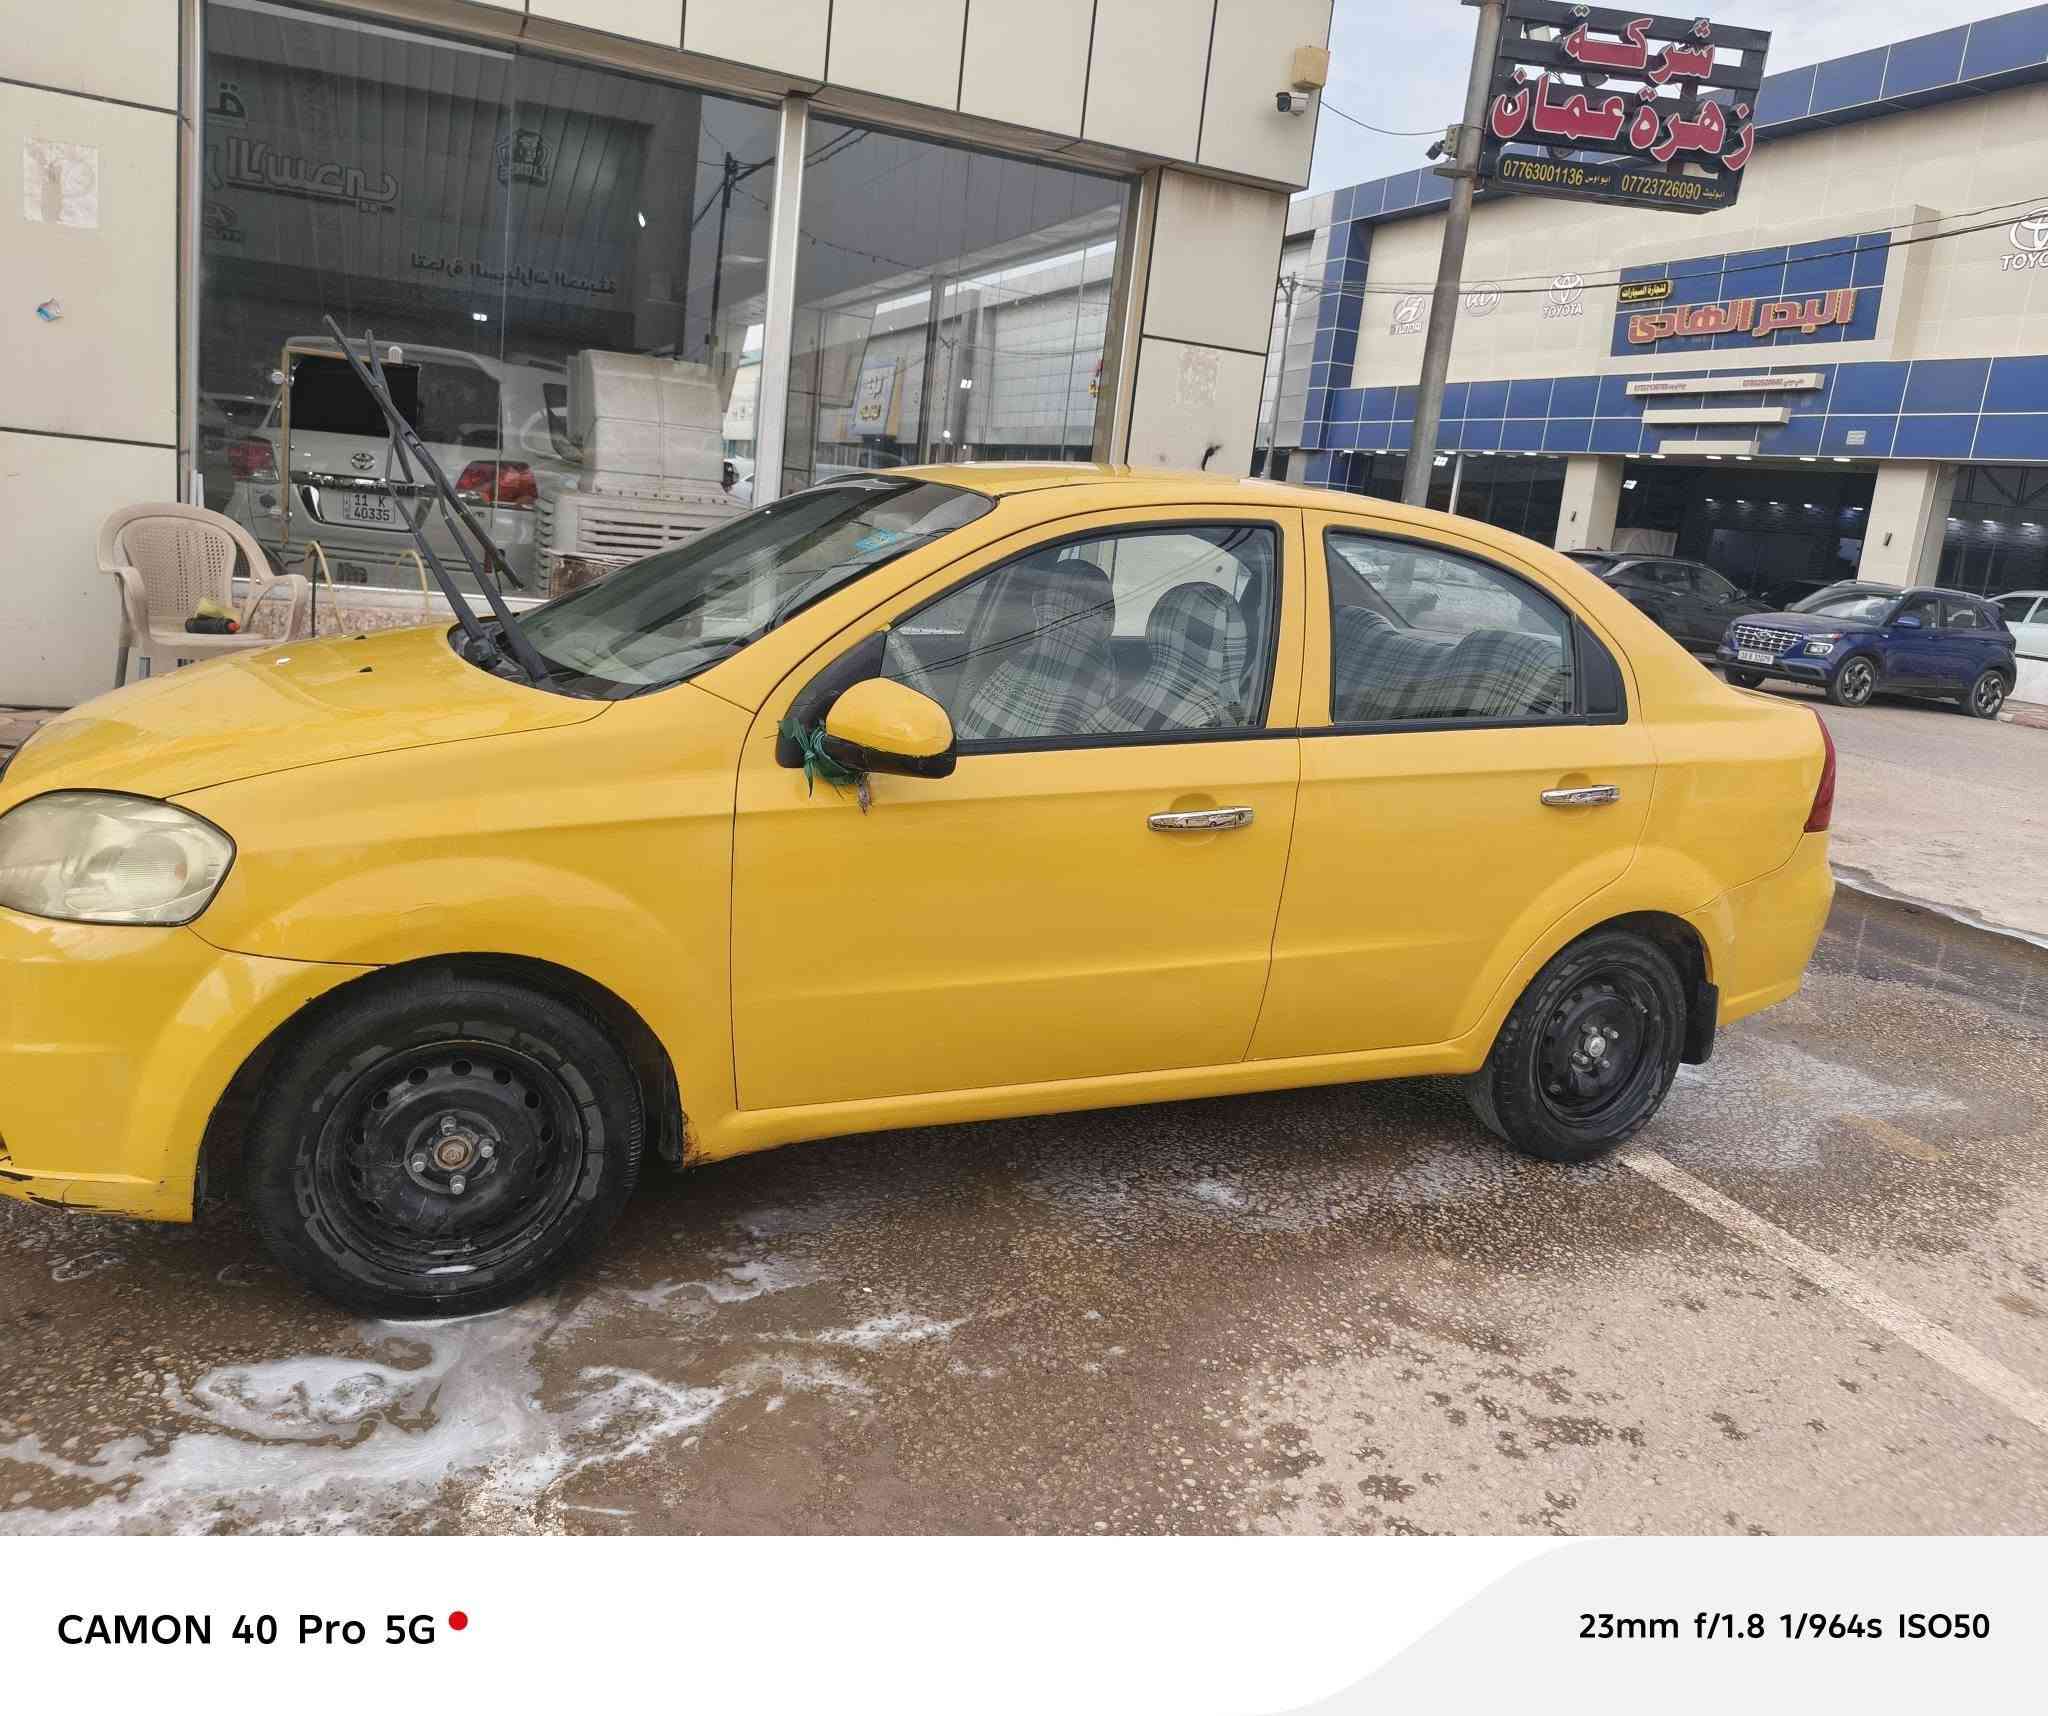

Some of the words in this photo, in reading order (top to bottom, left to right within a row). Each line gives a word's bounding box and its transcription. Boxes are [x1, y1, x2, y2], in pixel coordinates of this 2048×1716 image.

[1565, 4, 1715, 84] شركة
[1492, 67, 1625, 139] عمان
[1630, 87, 1755, 171] زهرة
[1503, 160, 1584, 185] 07763001136
[1622, 175, 1701, 200] 07723726090
[1543, 303, 1584, 319] TOYOTA
[1752, 288, 1857, 337] البحر
